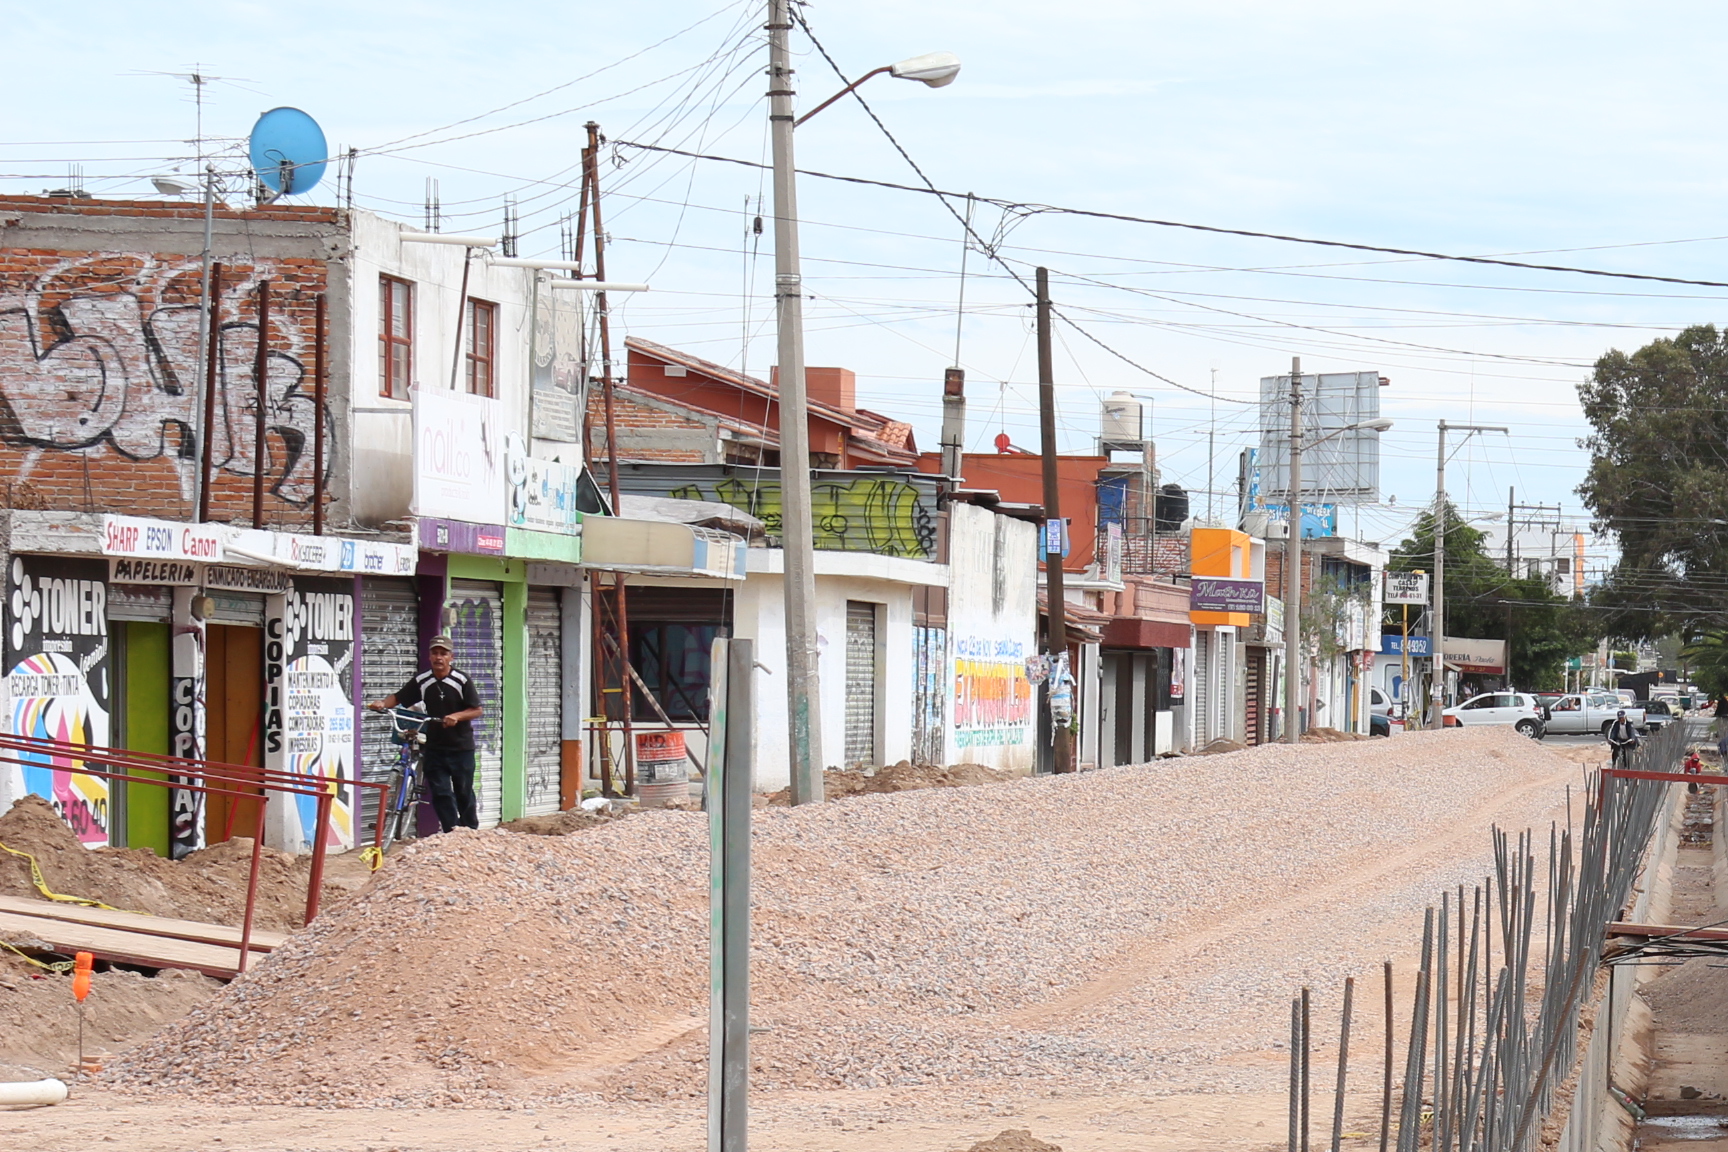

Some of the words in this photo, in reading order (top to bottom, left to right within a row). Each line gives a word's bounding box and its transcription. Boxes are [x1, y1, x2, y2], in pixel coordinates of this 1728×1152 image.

[106, 521, 139, 552] SHARP
[146, 526, 173, 552] EPSON
[181, 528, 217, 558] Canon
[114, 559, 195, 583] PAPELERIA
[39, 576, 107, 636] TONER
[305, 592, 354, 641] TONER
[11, 675, 39, 697] RECARGA
[265, 617, 285, 754] COPIAS
[287, 672, 329, 689] MANTENIMIENTO
[288, 694, 321, 710] COPIADORAS
[288, 715, 325, 731] COMPUTADORAS
[173, 680, 196, 839] COPIAS
[71, 799, 89, 836] 60
[92, 797, 108, 835] 40
